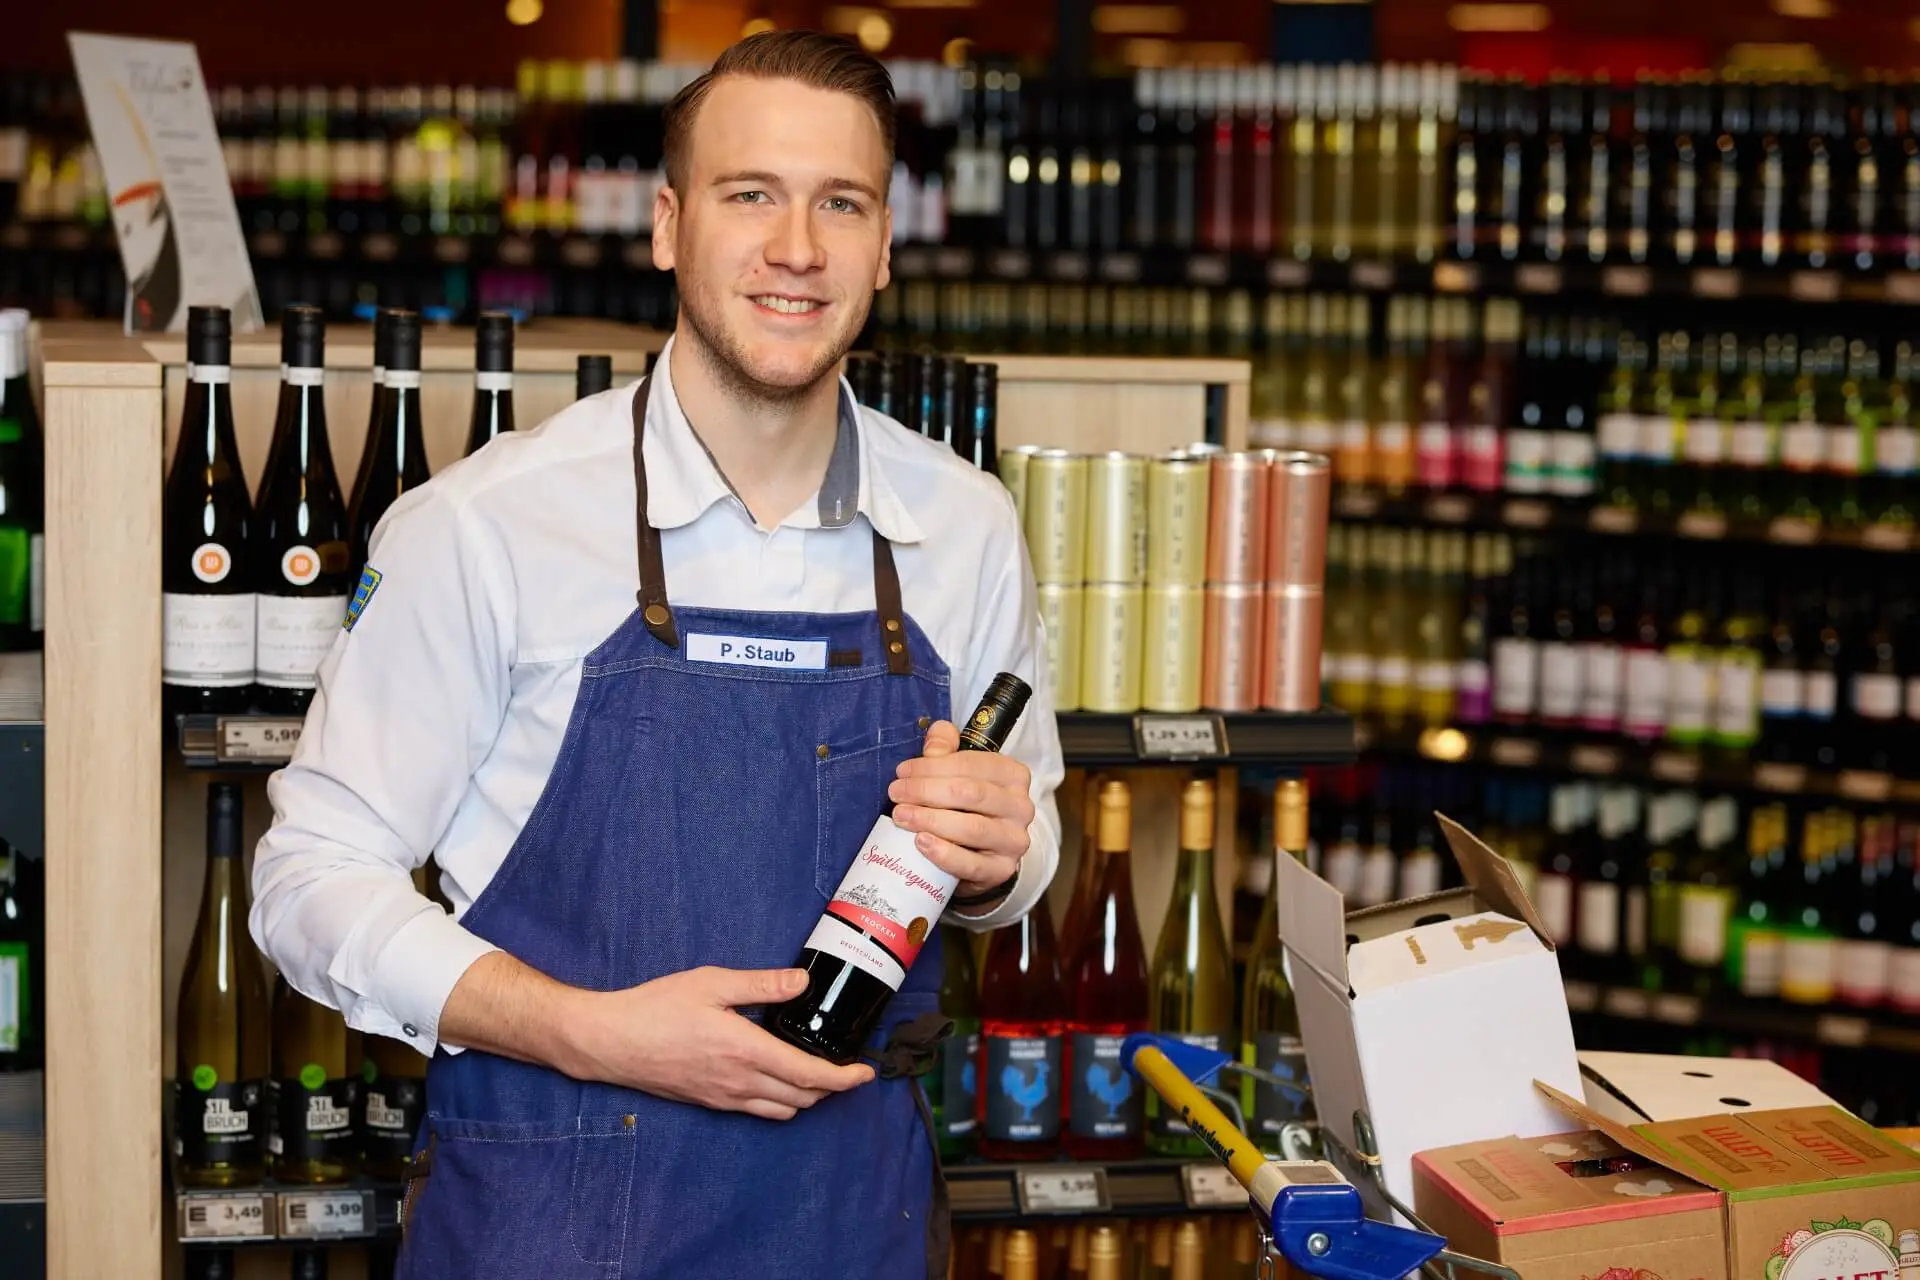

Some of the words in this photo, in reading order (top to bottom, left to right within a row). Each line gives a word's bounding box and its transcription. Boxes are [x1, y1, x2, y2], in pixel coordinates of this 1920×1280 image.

[745, 644, 795, 663] Staub
[862, 845, 945, 905] Spätburgunder
[860, 914, 896, 940] TROCKEN
[840, 939, 884, 968] DEUTSCHLAND
[224, 1206, 262, 1221] 3,49
[324, 1203, 362, 1218] 3,99
